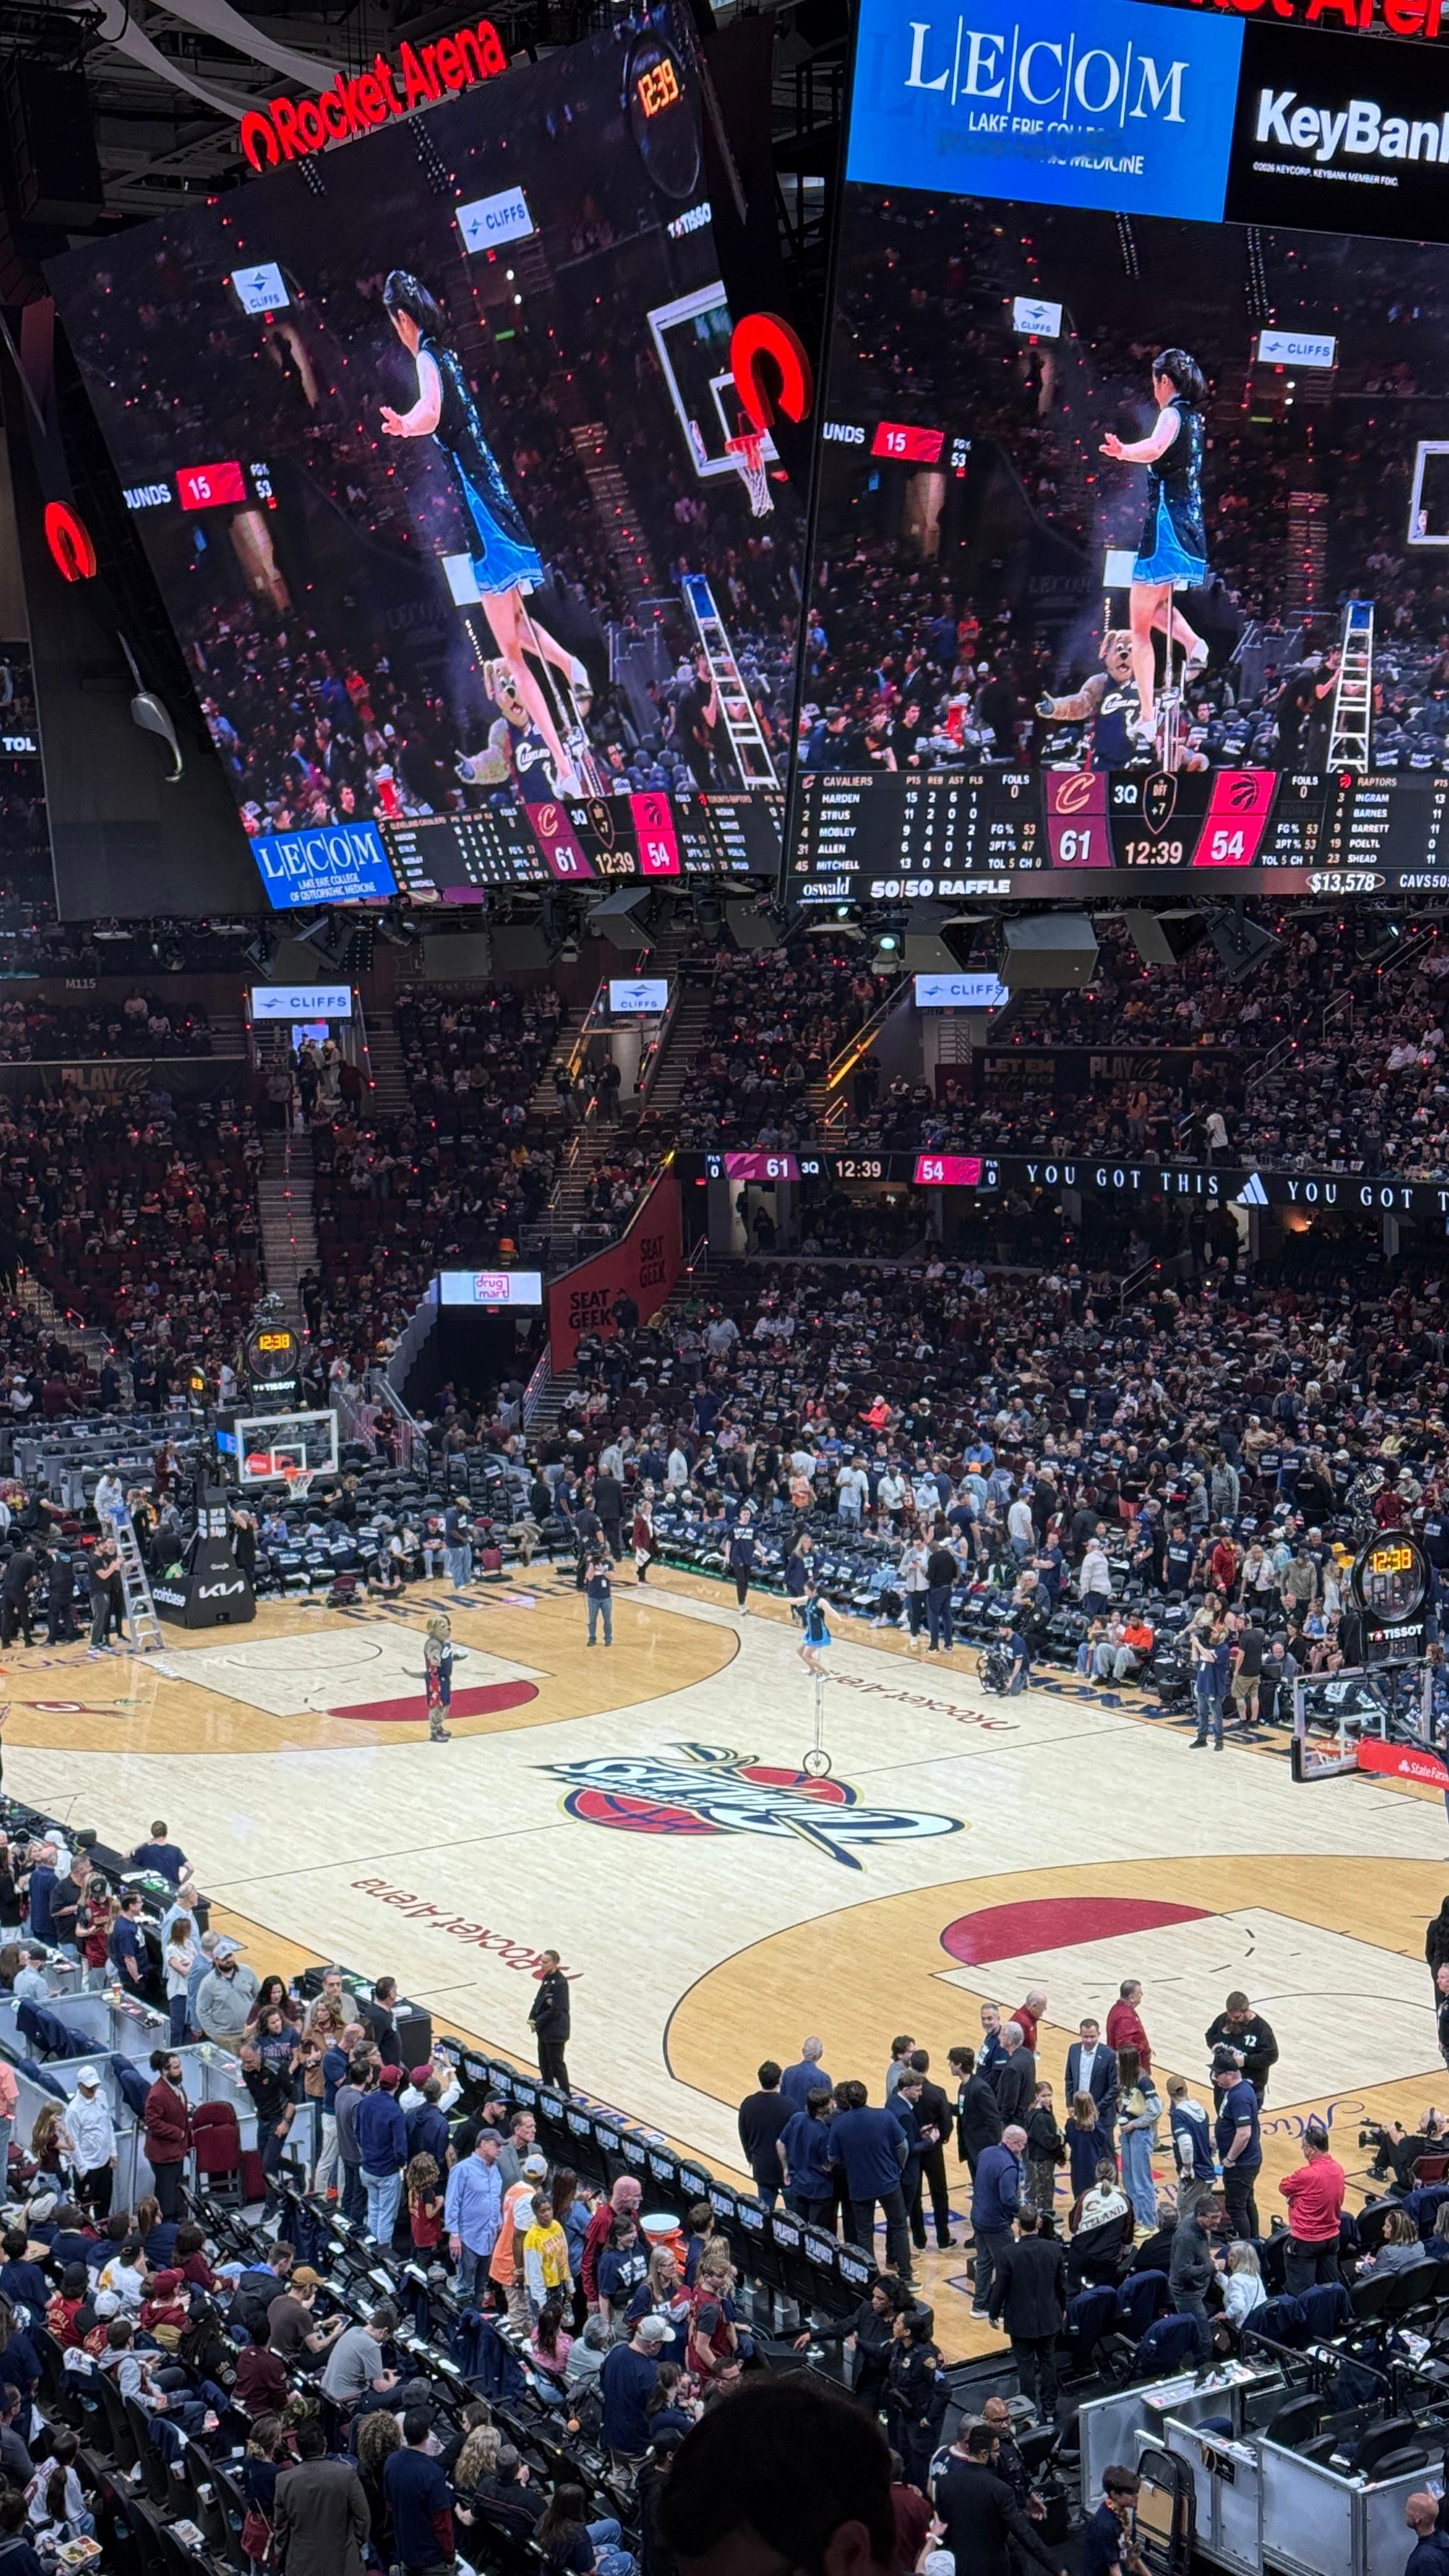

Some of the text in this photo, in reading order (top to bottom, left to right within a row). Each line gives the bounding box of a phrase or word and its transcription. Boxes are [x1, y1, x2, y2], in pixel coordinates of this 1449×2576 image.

[904, 22, 1190, 123] LECOM
[268, 19, 507, 157] Rocket Arena
[638, 59, 679, 118] 12:39
[1313, 169, 1347, 181] KEYBANK
[1348, 172, 1380, 185] MEMBER
[485, 204, 525, 231] CLIFFS
[250, 293, 280, 309] CLIFFS
[1020, 320, 1052, 334] CLIFFS
[1287, 342, 1330, 358] CLIFFS
[887, 433, 906, 452] 15
[951, 452, 966, 467] 53
[188, 476, 211, 500] 15
[256, 480, 272, 498] 53
[3, 737, 36, 751] TOL
[823, 776, 983, 786] CAVALIERS PTS REB AST FLS
[1002, 775, 1030, 785] FOULS
[1292, 776, 1319, 785] FOULS
[1357, 778, 1397, 787] RAPTORS
[804, 792, 976, 803] 1 HARDEN 15 2 6 1
[1011, 785, 1018, 798] 0
[1114, 786, 1137, 804] 3Q
[1153, 785, 1167, 796] DIFF
[1300, 786, 1307, 798] 0
[1338, 793, 1445, 804] 3 INGRAM 13
[802, 808, 977, 821] 2 STRUS 11 2 0 0
[1151, 803, 1165, 815] +7
[1337, 808, 1441, 818] 4 BARNES 11
[571, 809, 587, 825] 3Q
[801, 825, 975, 838] 4 MOBLEY 9 4 2 2
[991, 824, 1036, 835] FG % 53
[1277, 824, 1318, 834] FG % 53
[1334, 823, 1440, 834] 9 BARRETT 11
[797, 841, 972, 855] 31 ALLEN 6 4 0 1
[989, 841, 1034, 852] 3PT % 47
[1060, 831, 1091, 861] 61
[1211, 831, 1244, 861] 54
[1275, 839, 1316, 850] 3PT % 53
[1330, 838, 1436, 848] 19 POELTL 0
[258, 832, 382, 878] LECOM
[555, 847, 578, 872] 61
[647, 843, 670, 868] 54
[1125, 842, 1183, 864] 12:39
[1262, 856, 1313, 865] TOL 5 CH 1
[1328, 854, 1436, 864] 23 SHEAD 11
[595, 852, 635, 874] 12:39
[795, 857, 972, 871] 45 MITCHELL 13 0 4 2
[988, 858, 1041, 869] TOL 5 CH 0
[802, 877, 850, 896] oswald
[870, 879, 1011, 898] 50/50 RAFFLE
[1311, 873, 1375, 894] $13,578
[66, 978, 96, 990] M115
[950, 985, 1004, 996] CLIFFS
[290, 995, 346, 1008] CLIFFS
[620, 1000, 657, 1009] CLIFFS
[1090, 1056, 1134, 1079] PLAY
[710, 1164, 719, 1178] 0
[767, 1158, 944, 1181] 61 3Q 12:39 54
[988, 1171, 996, 1185] 0
[1027, 1165, 1413, 1209] YOU GOT THIS YOU GOT
[641, 1235, 664, 1262] SEAT
[640, 1260, 666, 1289] GEEK
[476, 1276, 503, 1290] drug
[479, 1289, 508, 1299] mart
[571, 1289, 610, 1308] SEAT
[569, 1308, 613, 1330] GEEK
[259, 1333, 291, 1351] 12:38
[1374, 1547, 1411, 1574] 12:38
[153, 1586, 186, 1607] coinbase
[1383, 1625, 1423, 1641] TISSOT
[882, 1690, 992, 1724] Rocket
[350, 1878, 545, 1970] Rocket Arena
[1243, 2034, 1257, 2048] 12
